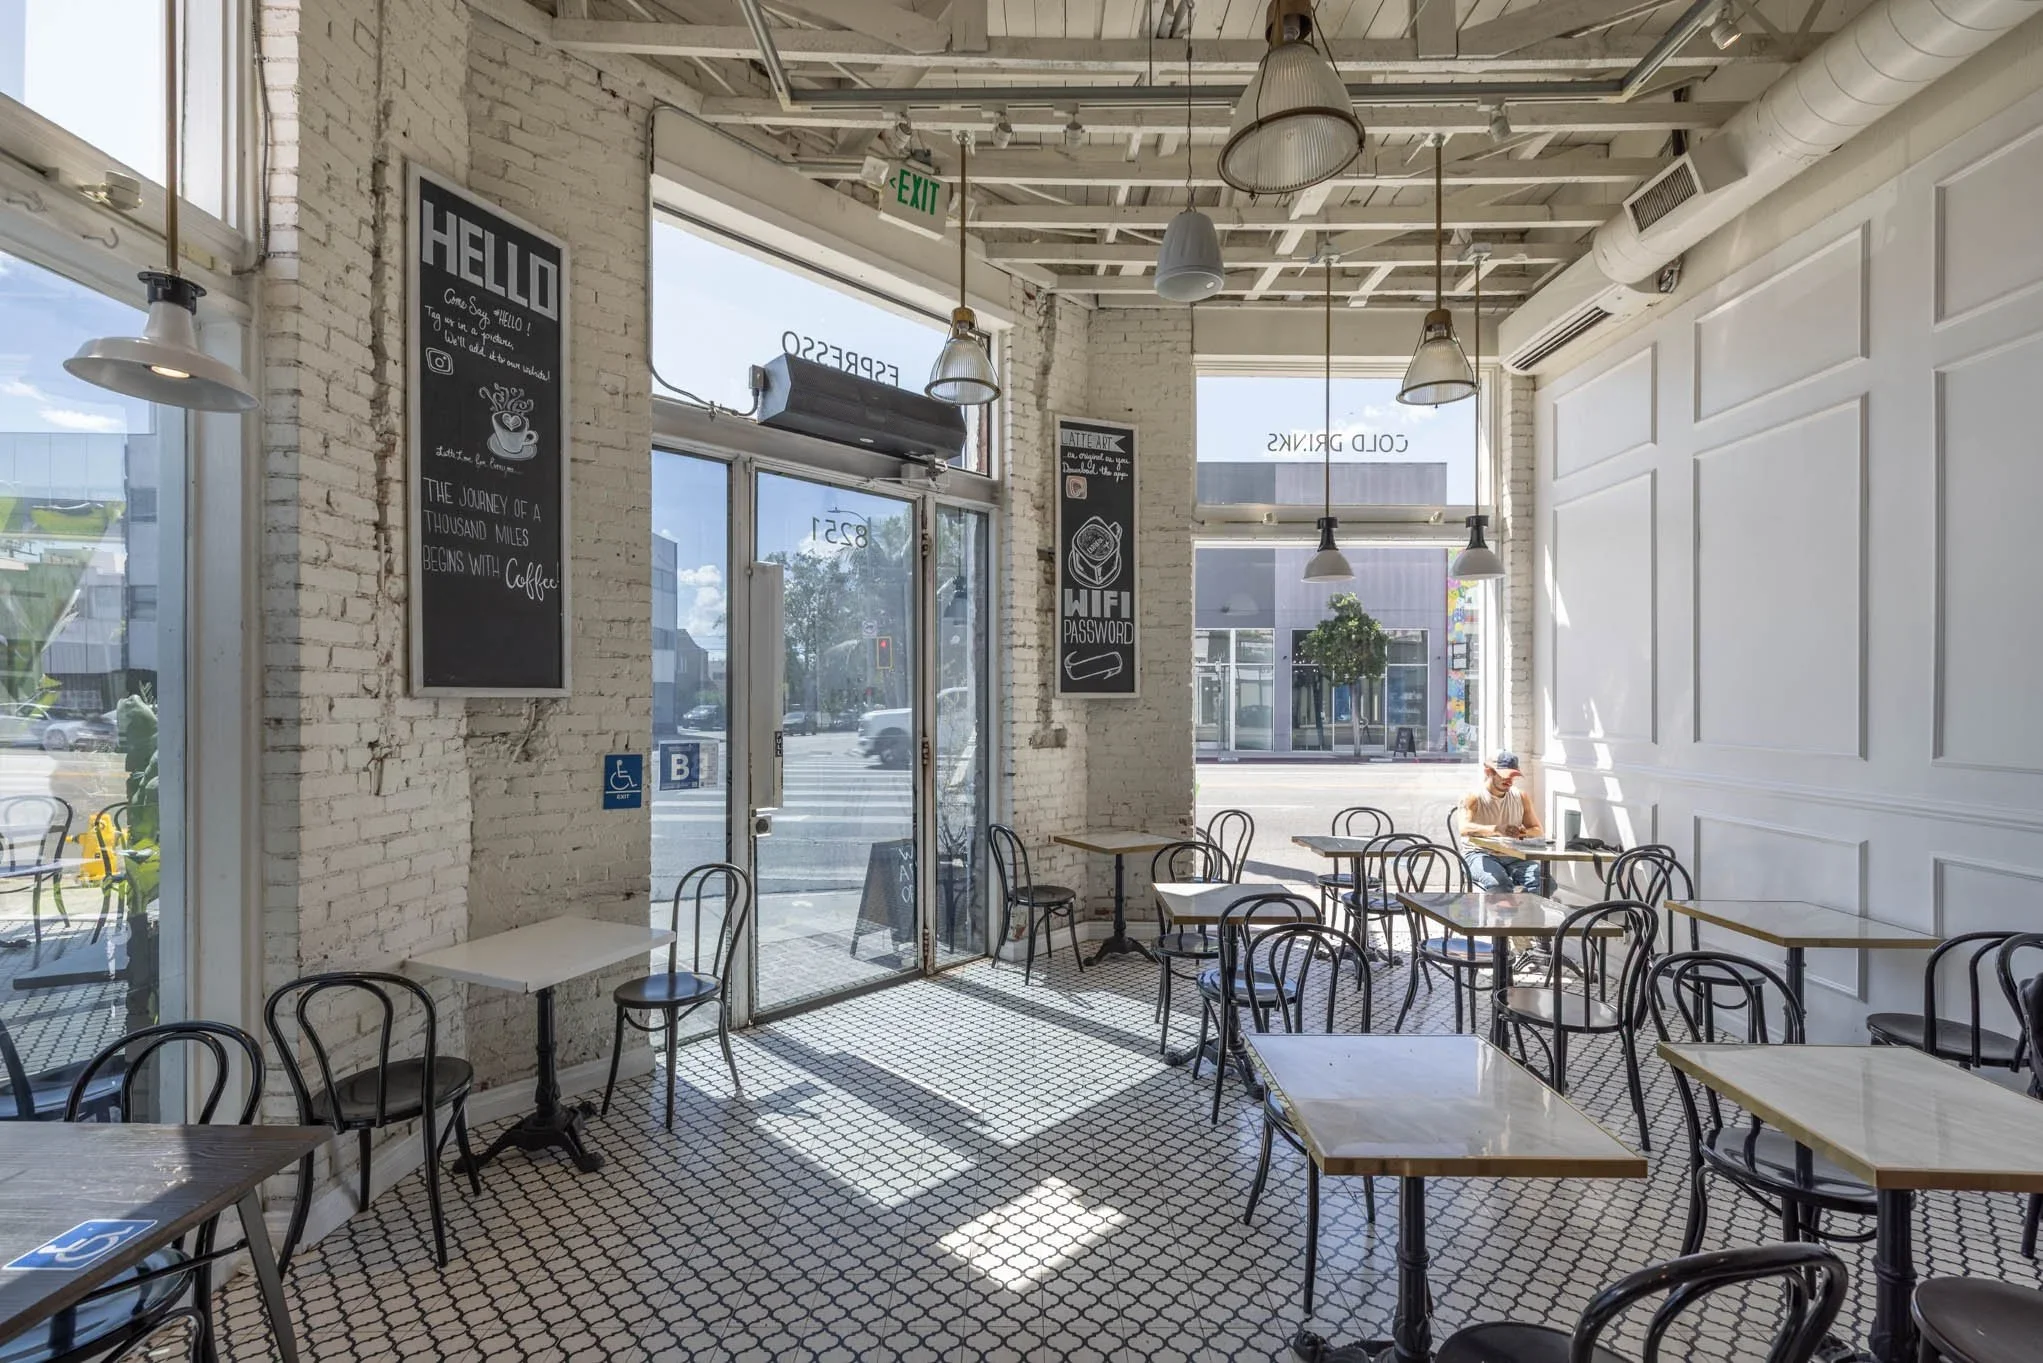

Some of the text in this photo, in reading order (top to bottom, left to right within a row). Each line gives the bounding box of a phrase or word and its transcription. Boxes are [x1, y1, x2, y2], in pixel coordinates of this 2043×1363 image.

[897, 168, 940, 215] EXIT
[422, 199, 558, 322] HELLO
[424, 305, 441, 331] Tag
[457, 321, 468, 332] in
[471, 327, 478, 335] a
[444, 288, 467, 310] Come
[469, 296, 490, 330] Say
[444, 330, 466, 348] We'll
[469, 344, 486, 357] add
[1061, 431, 1112, 450] LATTE ART
[423, 477, 541, 522] THE JOURNEY OF A
[423, 509, 529, 546] THOUSAND MILES
[423, 544, 464, 573] BEGINS
[468, 552, 500, 577] WITH
[1064, 588, 1130, 618] WIFI
[1064, 619, 1134, 644] PASSWORD
[671, 753, 690, 780] B
